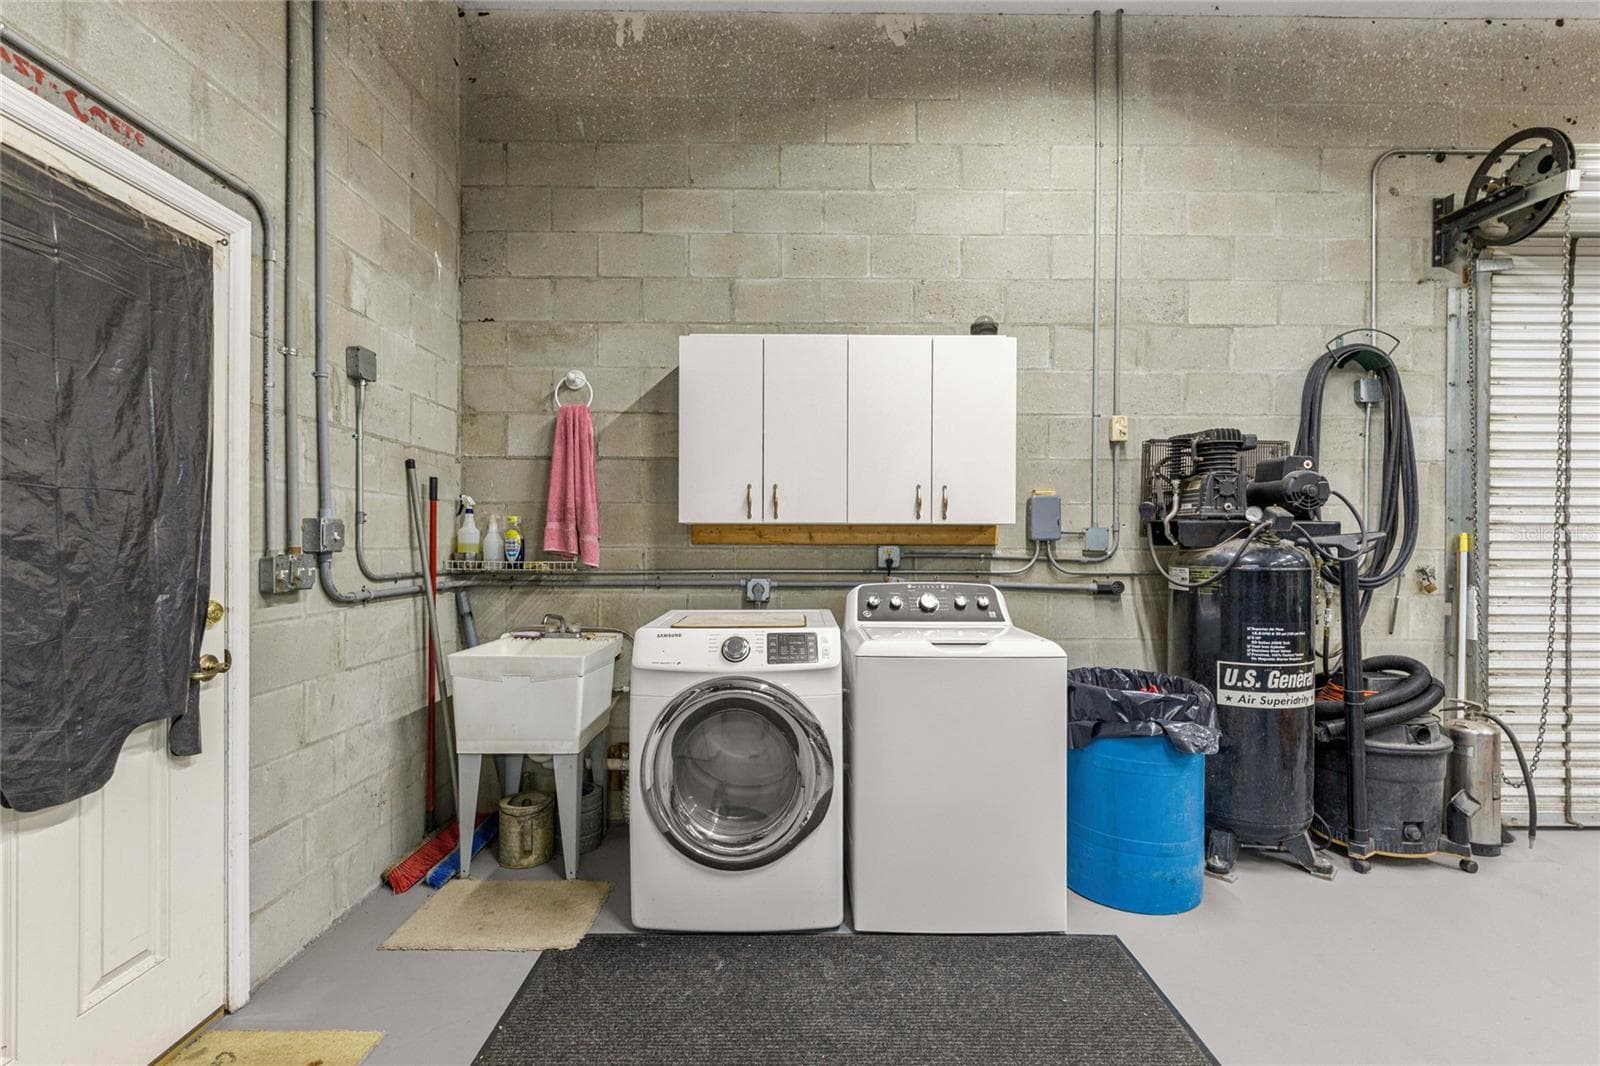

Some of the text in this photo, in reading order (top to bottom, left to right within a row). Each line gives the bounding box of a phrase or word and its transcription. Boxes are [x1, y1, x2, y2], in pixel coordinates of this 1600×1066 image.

[1223, 667, 1314, 689] U.S. General
[1237, 694, 1256, 704] Air
